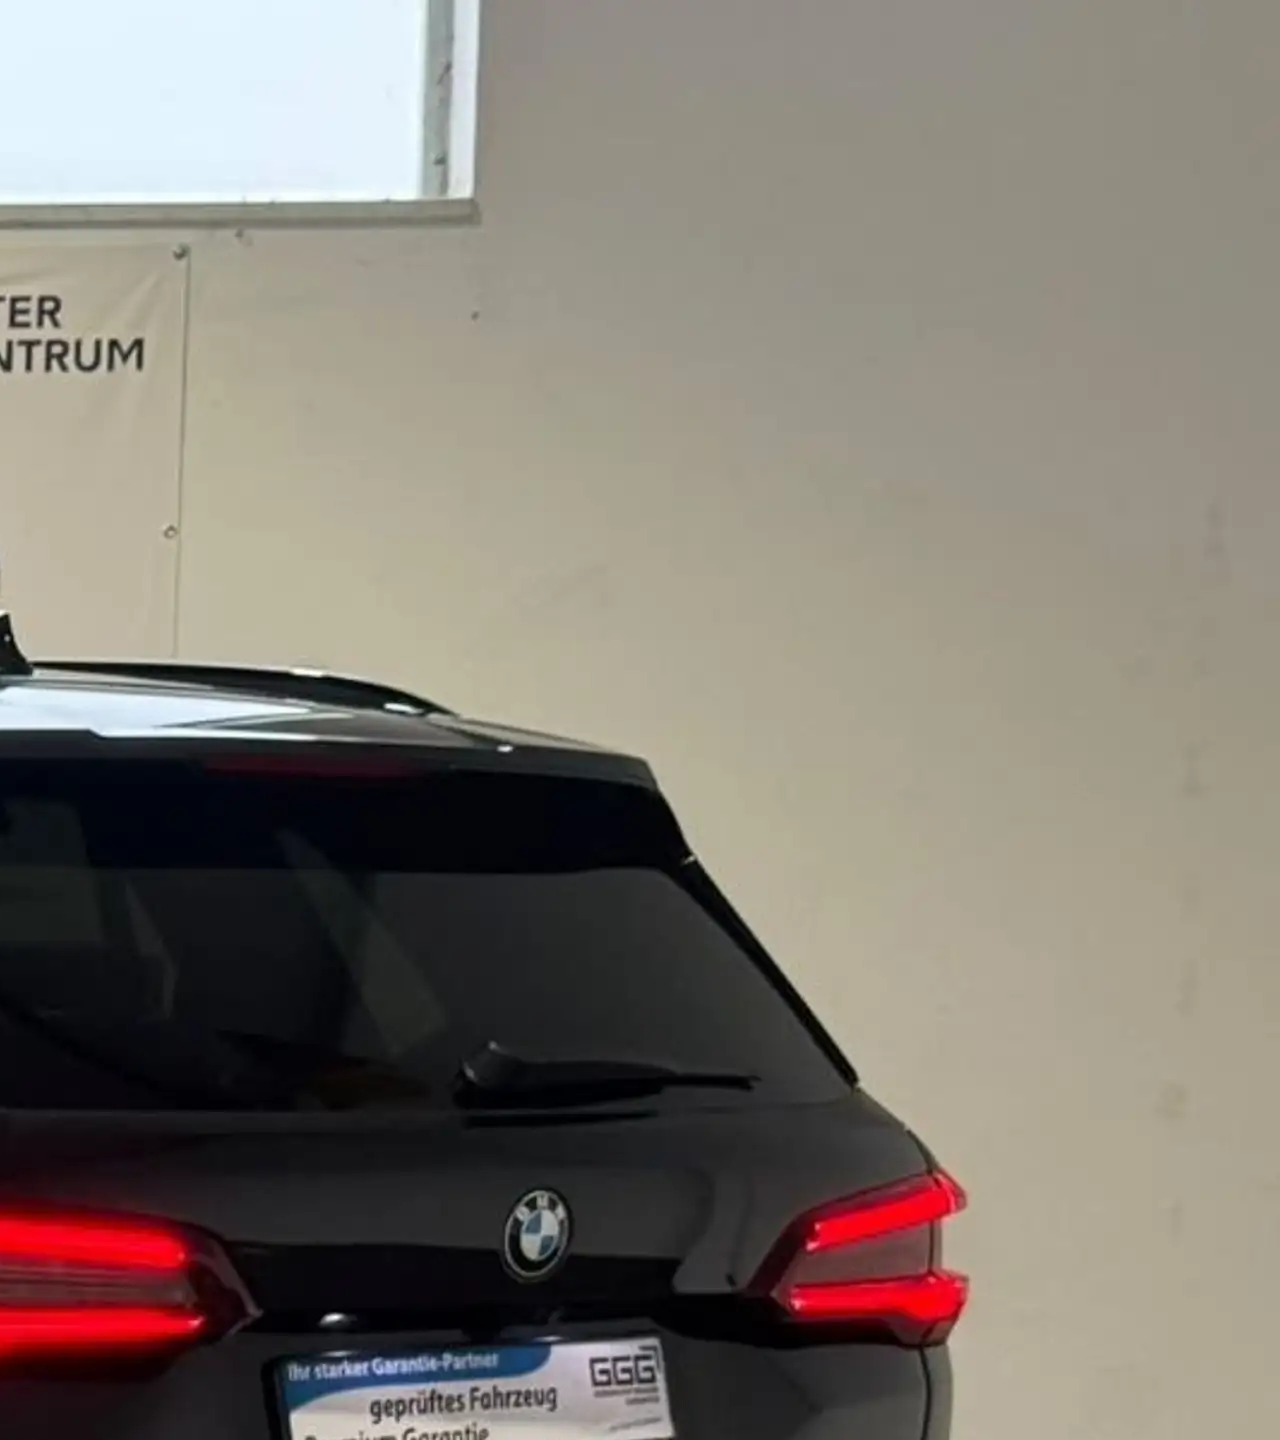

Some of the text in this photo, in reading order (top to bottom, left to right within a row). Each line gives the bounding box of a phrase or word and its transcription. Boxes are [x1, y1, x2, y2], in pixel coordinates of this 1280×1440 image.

[288, 1353, 500, 1382] Ihr starker Garantie-Partner
[369, 1385, 558, 1425] geprüftes Fahrzeug
